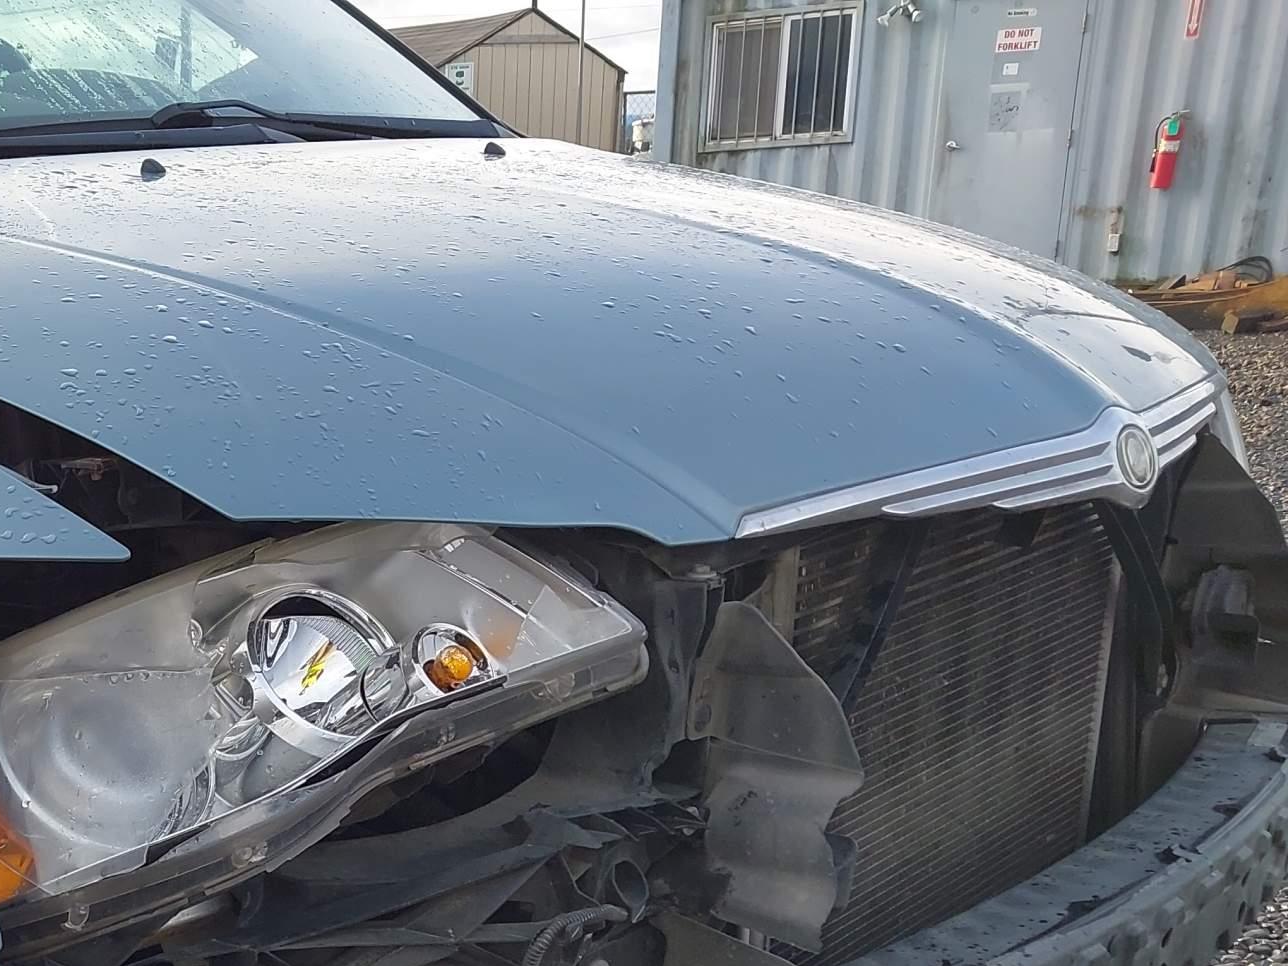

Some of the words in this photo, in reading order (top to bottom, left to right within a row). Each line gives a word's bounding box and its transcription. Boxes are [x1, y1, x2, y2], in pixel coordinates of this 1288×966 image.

[1004, 30, 1016, 38] DO
[1017, 29, 1035, 37] NOT
[997, 41, 1038, 50] FORKLIFT
